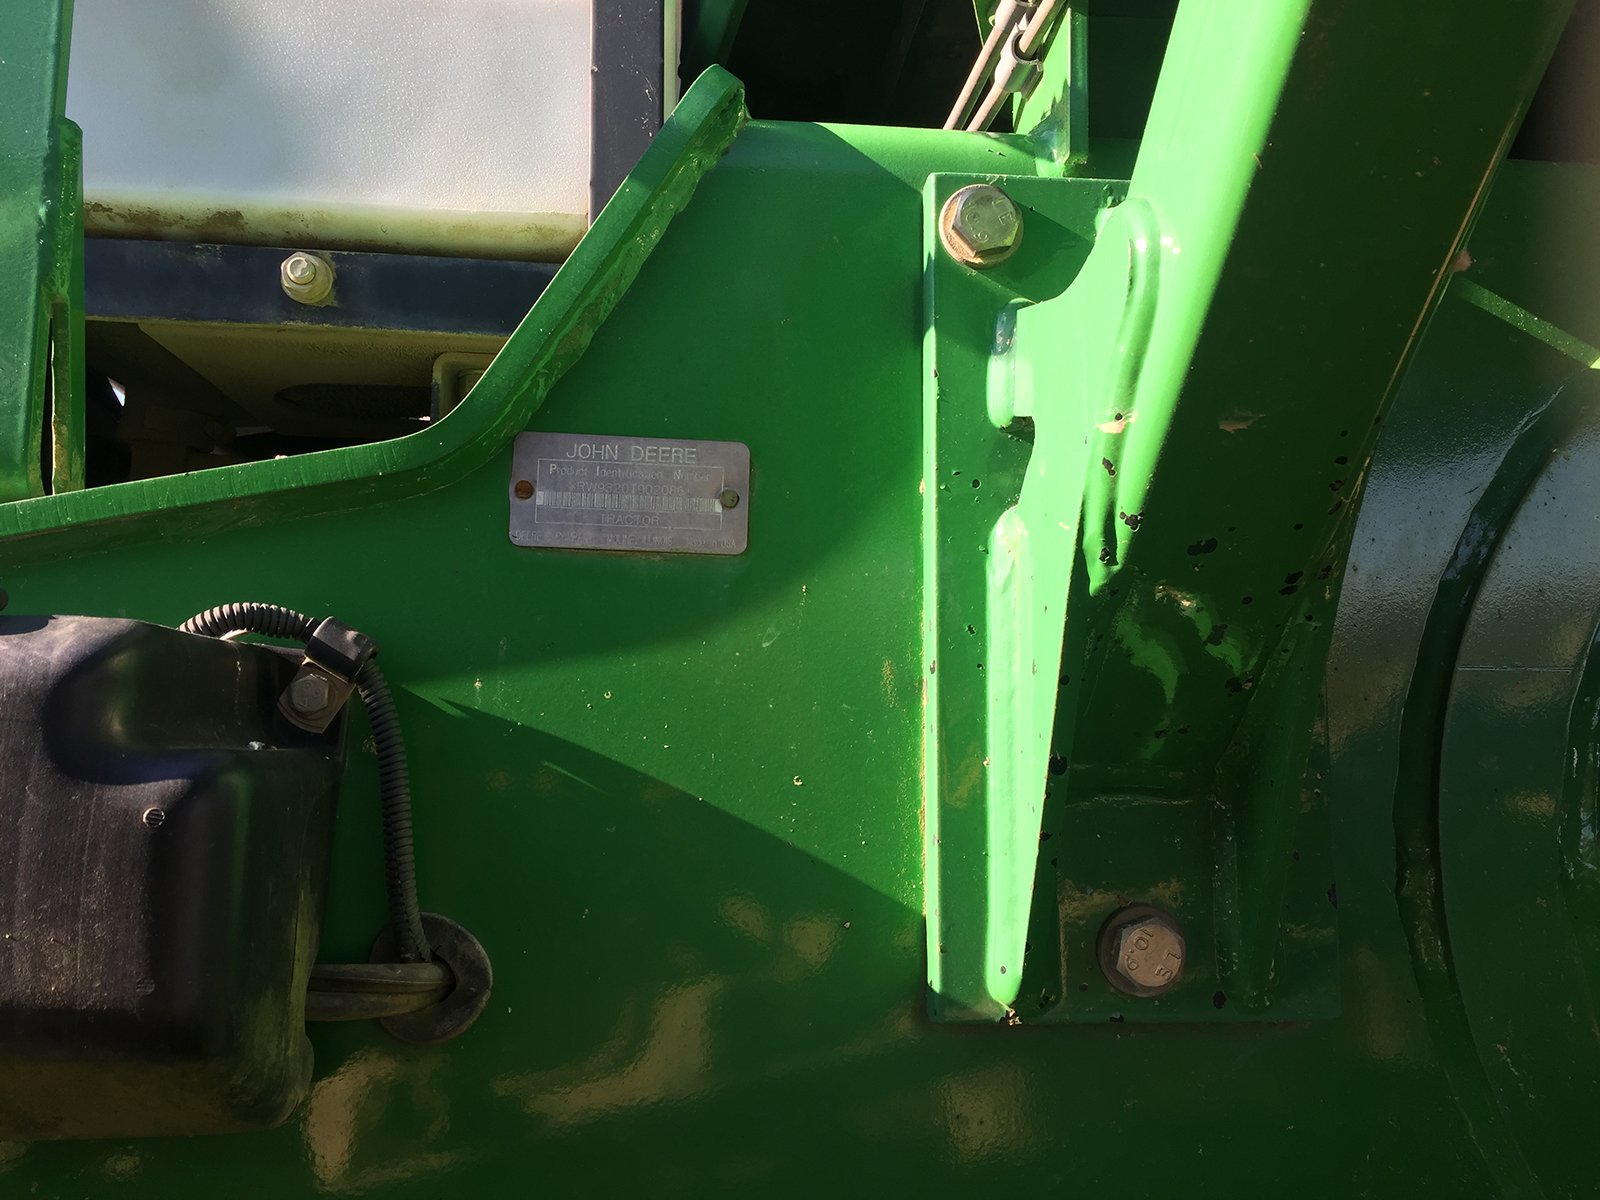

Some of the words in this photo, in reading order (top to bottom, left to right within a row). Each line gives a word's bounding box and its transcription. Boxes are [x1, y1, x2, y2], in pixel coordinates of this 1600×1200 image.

[566, 443, 619, 460] JOHN
[631, 445, 697, 464] DEERE
[549, 463, 588, 477] Product
[596, 465, 664, 481] Identification
[673, 469, 711, 482] Number
[600, 513, 660, 526] TRACTOR
